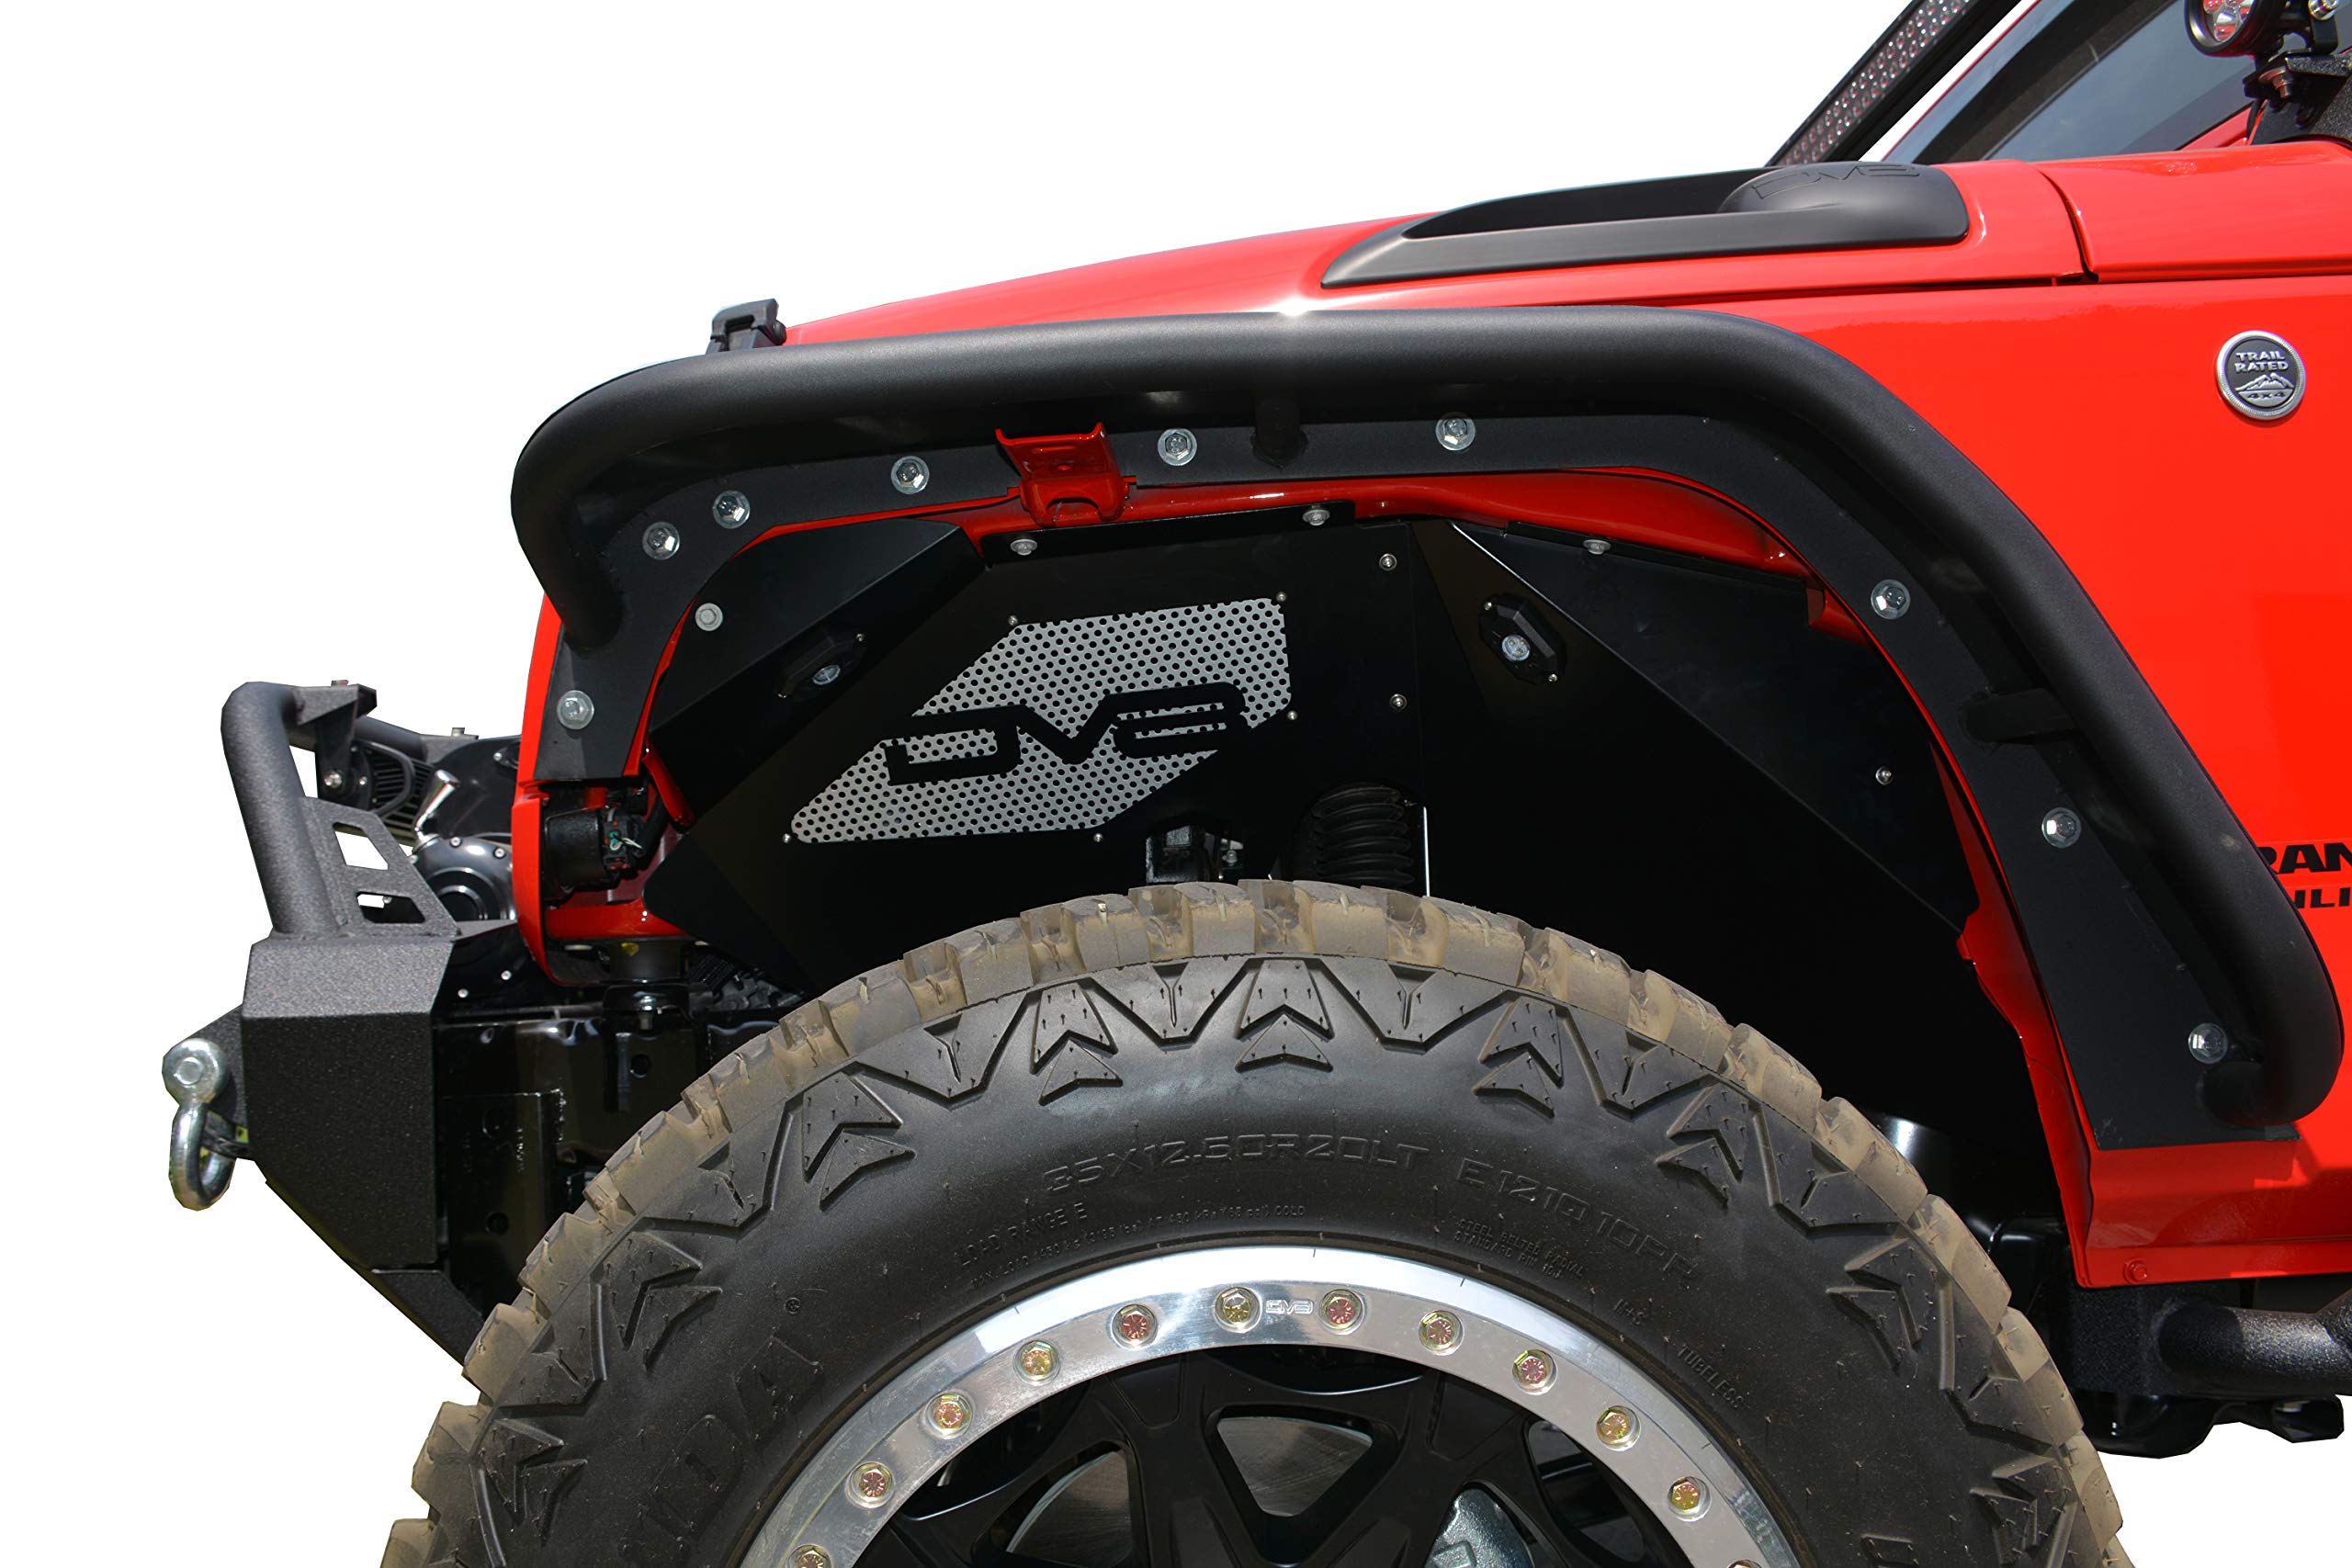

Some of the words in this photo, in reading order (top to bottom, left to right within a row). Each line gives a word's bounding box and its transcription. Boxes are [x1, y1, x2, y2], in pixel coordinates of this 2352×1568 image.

[2233, 361, 2289, 373] RATED
[2235, 351, 2285, 362] TRAIL
[1273, 1204, 1306, 1217] COLD
[954, 1234, 1001, 1268] LOAD
[1007, 1208, 1069, 1241] RANGE
[1073, 1201, 1088, 1220] E
[1453, 1231, 1513, 1258] STANDARD
[1455, 1219, 1493, 1238] STEEL
[1500, 1231, 1542, 1256] BELTED
[1544, 1247, 1585, 1277] RADIAL
[1678, 1342, 1746, 1409] TUBELESS
